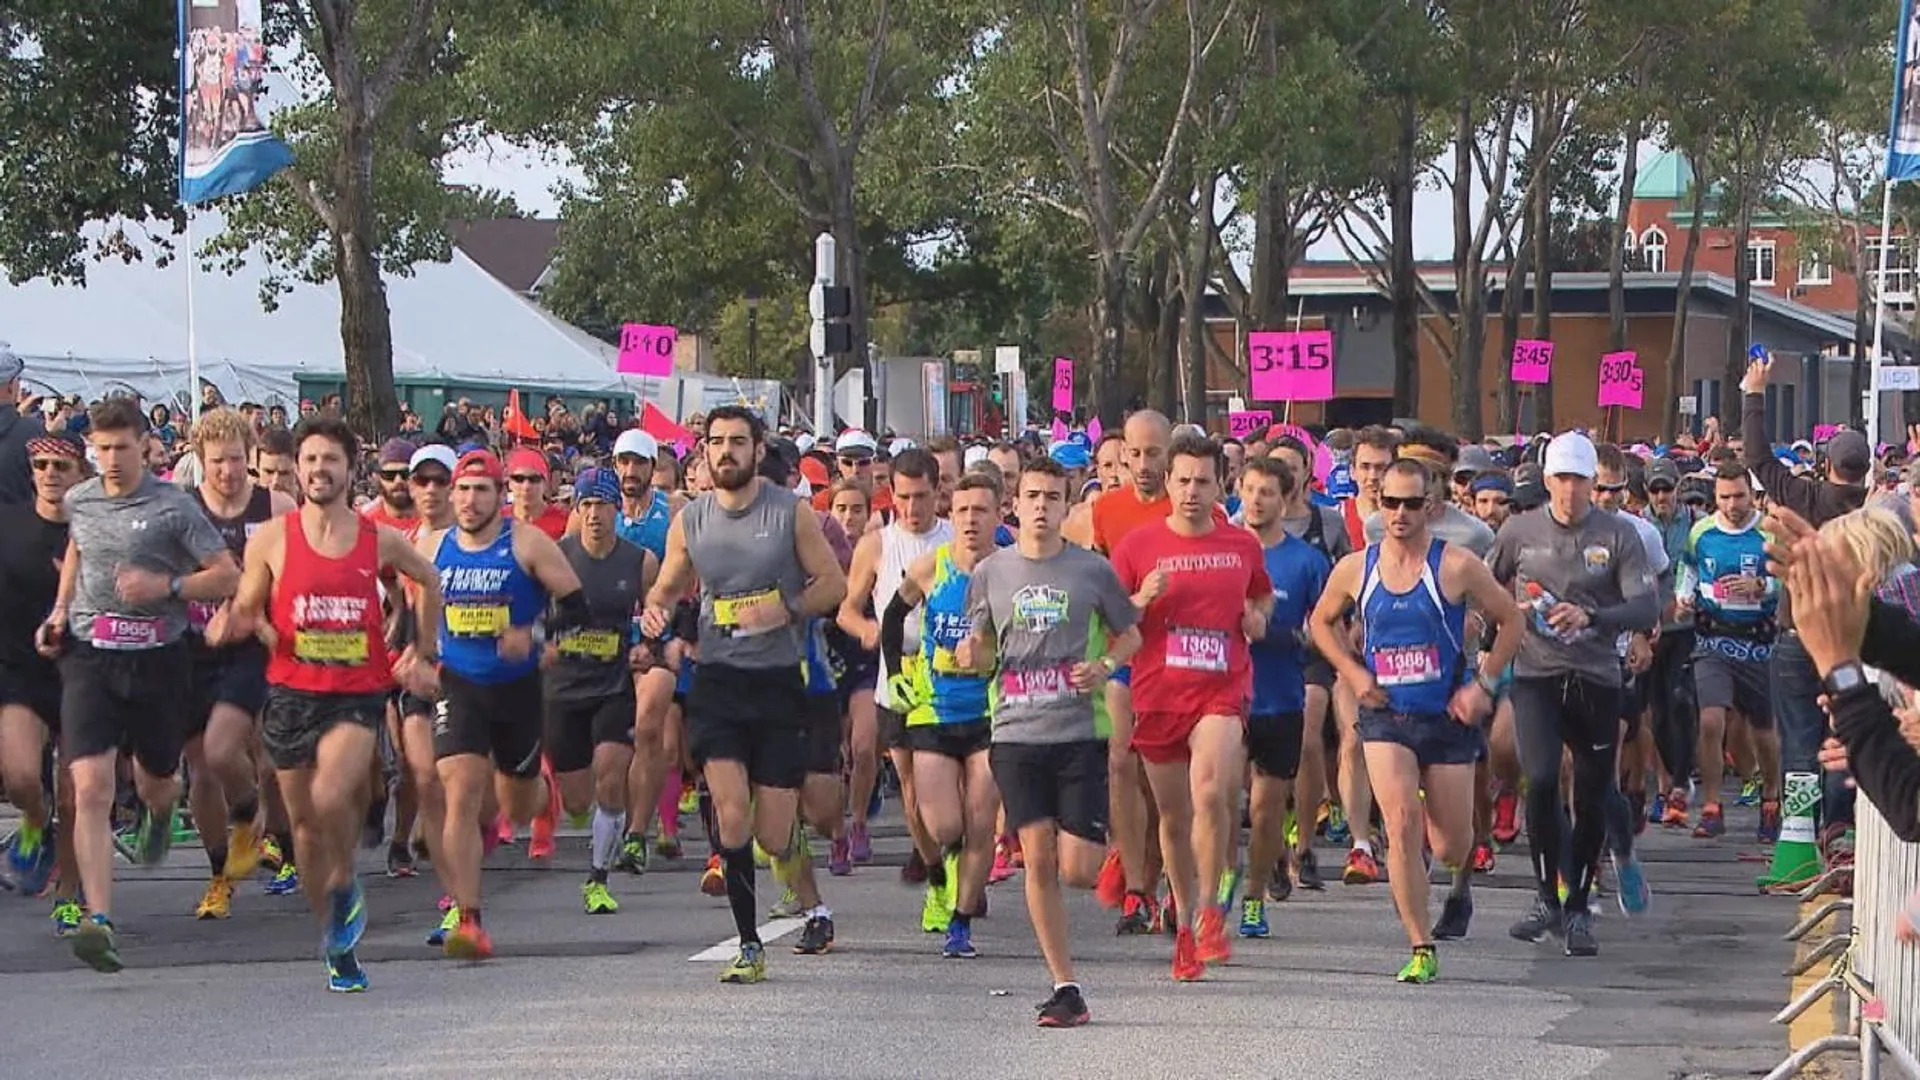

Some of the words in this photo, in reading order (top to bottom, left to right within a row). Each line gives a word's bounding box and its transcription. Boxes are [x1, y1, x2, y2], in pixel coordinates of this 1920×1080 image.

[1253, 343, 1329, 371] 3:15
[1514, 346, 1551, 365] 3:45
[1601, 360, 1632, 384] 3:30
[1232, 416, 1270, 431] 2:00
